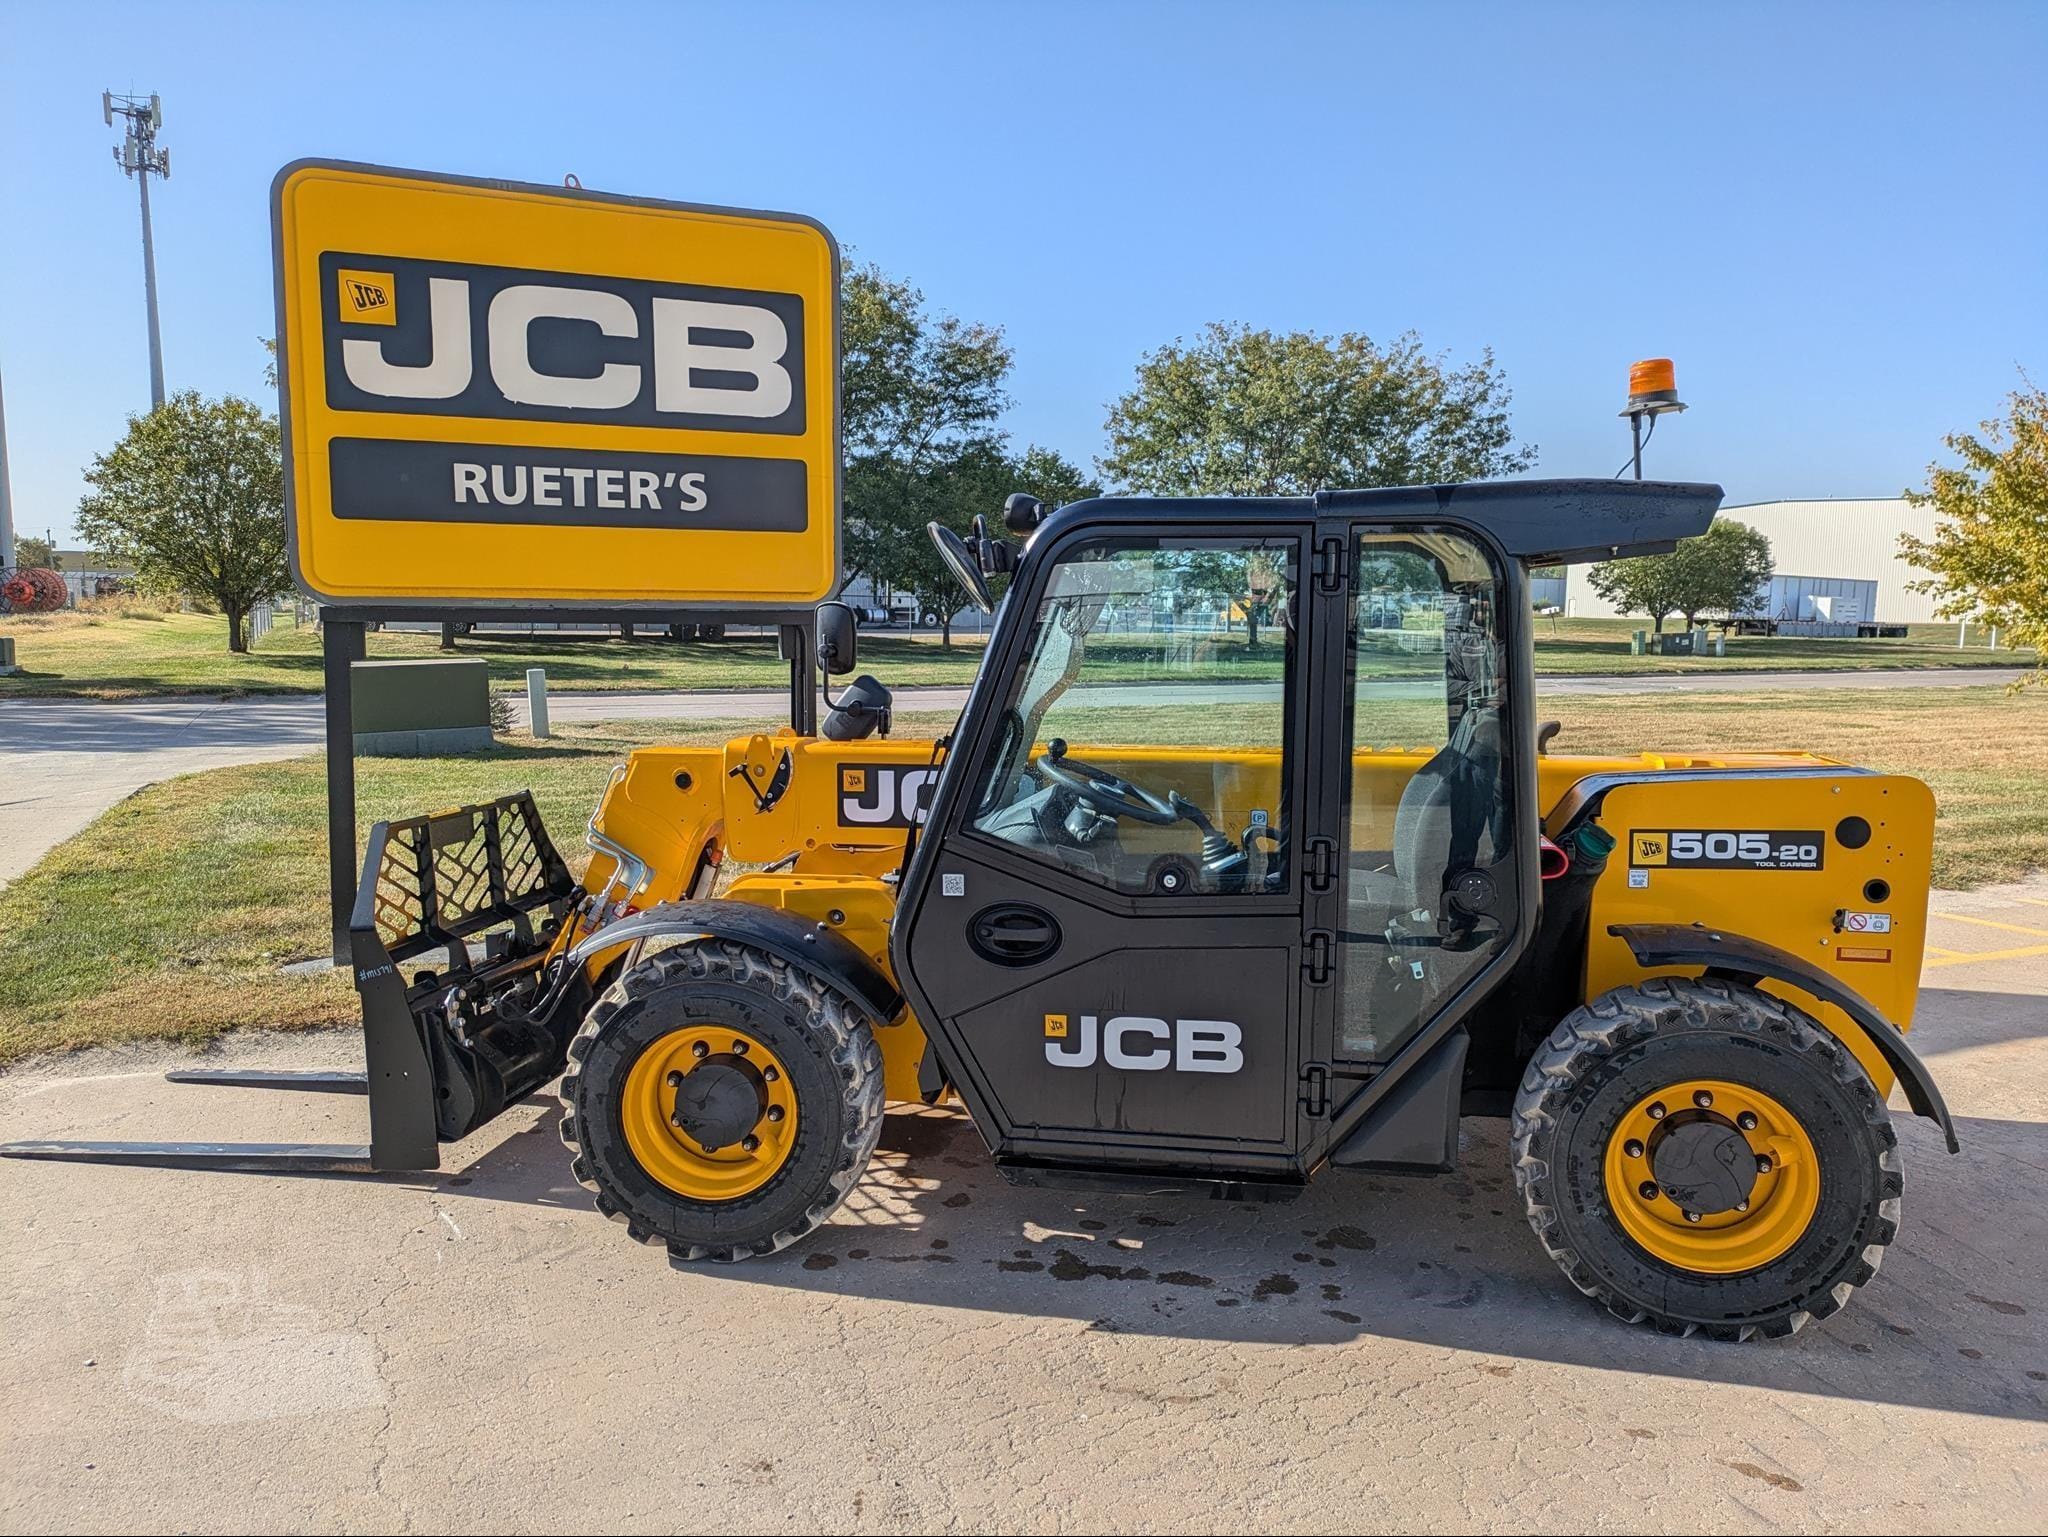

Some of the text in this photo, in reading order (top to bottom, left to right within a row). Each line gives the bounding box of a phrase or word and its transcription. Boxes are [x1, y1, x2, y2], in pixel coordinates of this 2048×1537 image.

[354, 284, 385, 308] JCB
[342, 277, 793, 418] JCB
[453, 463, 708, 512] RUETER'S
[1641, 839, 1662, 857] JCB
[1045, 1016, 1244, 1073] JCB
